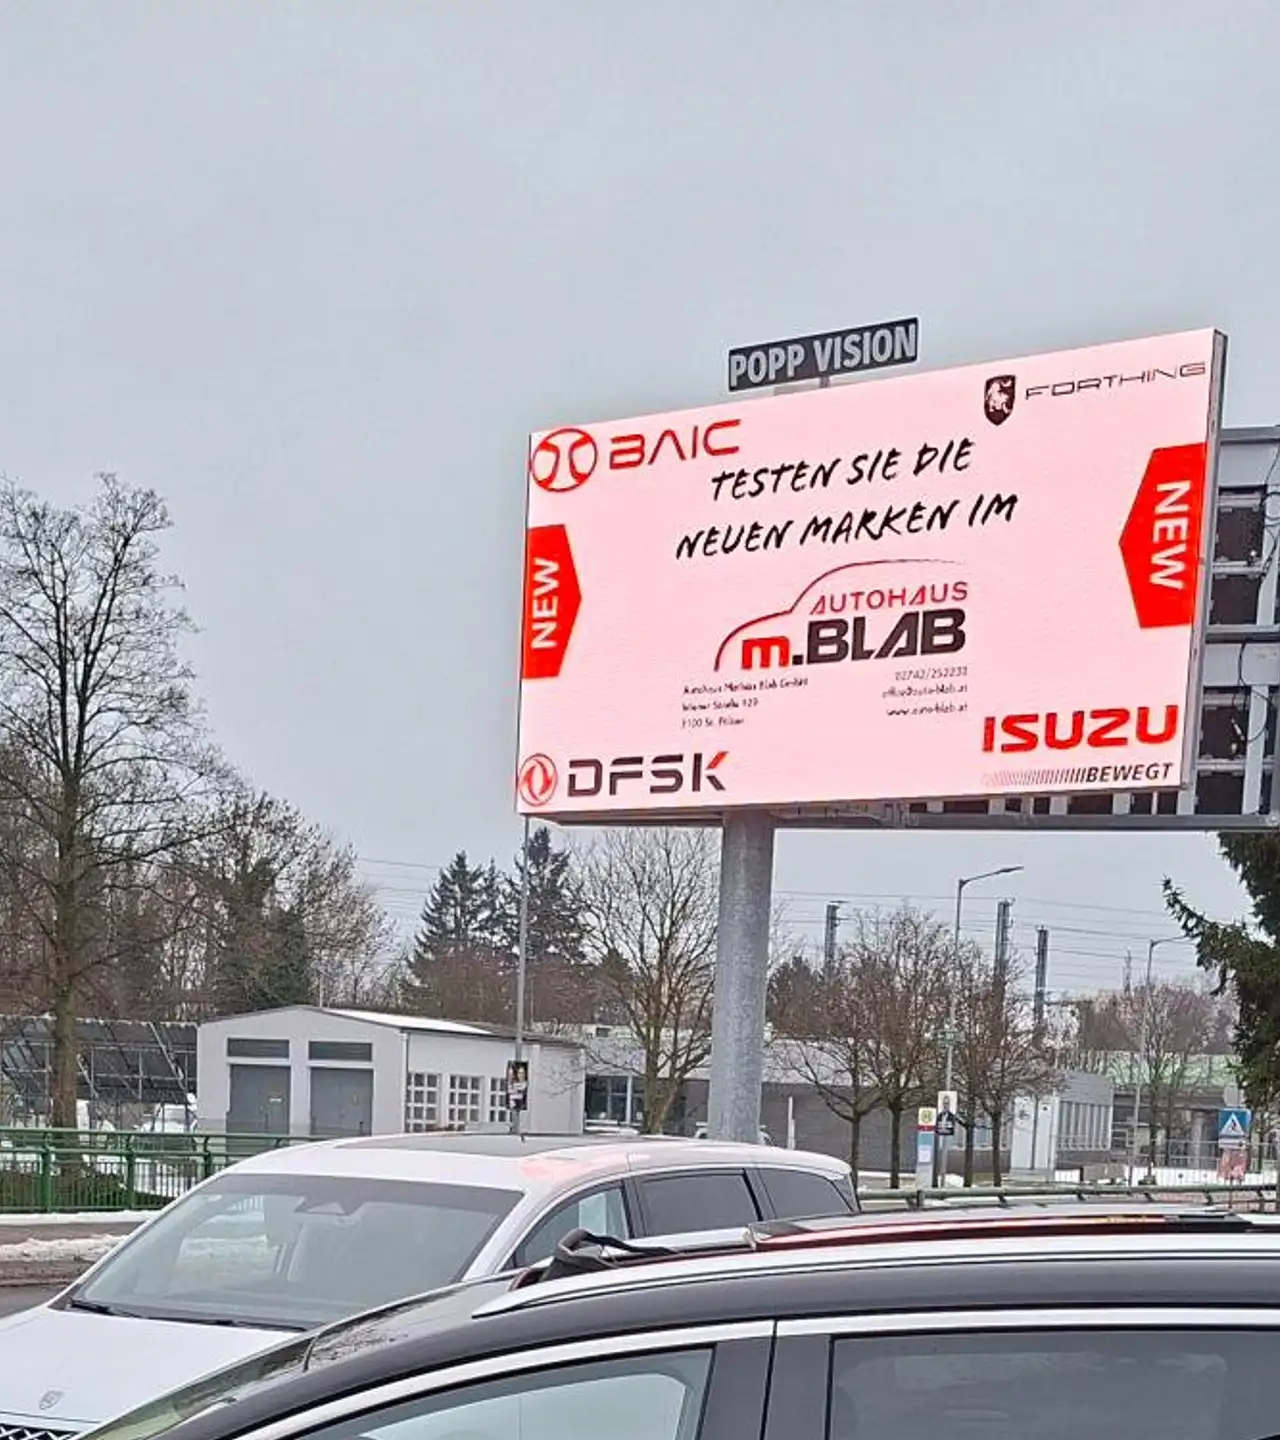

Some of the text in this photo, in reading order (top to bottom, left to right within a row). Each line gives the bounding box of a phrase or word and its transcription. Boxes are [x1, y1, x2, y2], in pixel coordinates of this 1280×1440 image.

[730, 323, 918, 388] POPP VISION
[1025, 361, 1207, 400] FORTHING
[609, 418, 742, 470] BAIC
[710, 437, 975, 501] TESTEN SIE DIE
[675, 492, 1019, 560] NEUEN MARKEN IM
[1149, 479, 1192, 591] NEW
[531, 556, 560, 650] NEW
[809, 581, 969, 616] AUTOHAUS
[981, 704, 1179, 753] ISUZU
[566, 750, 730, 798] DFSK
[1085, 762, 1174, 784] BEWEGT
